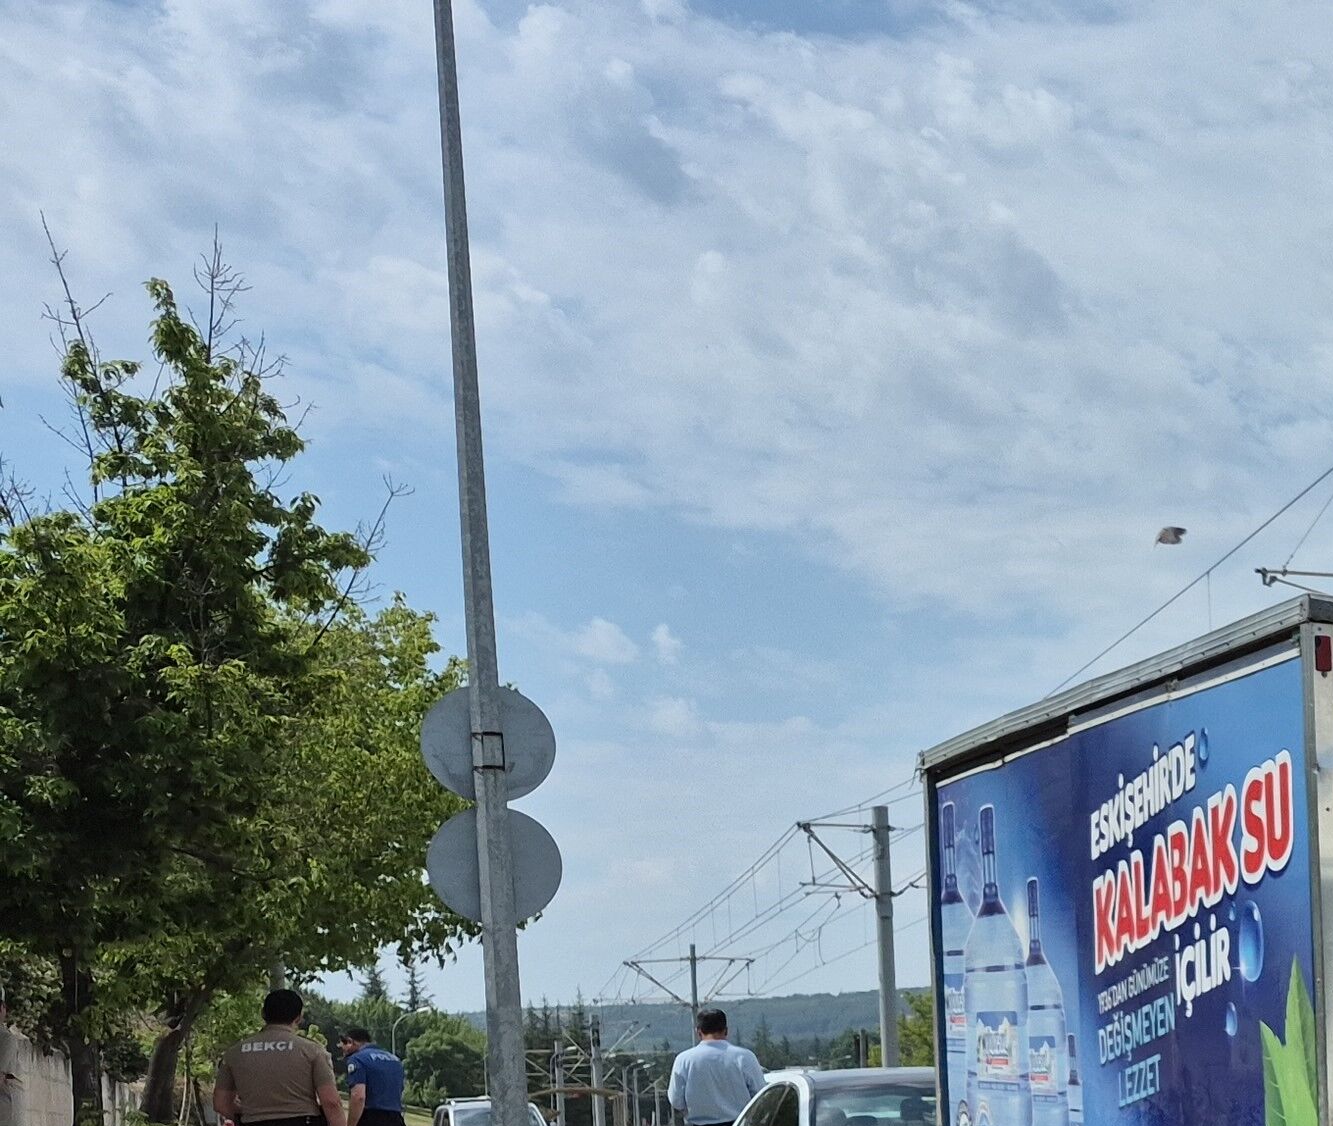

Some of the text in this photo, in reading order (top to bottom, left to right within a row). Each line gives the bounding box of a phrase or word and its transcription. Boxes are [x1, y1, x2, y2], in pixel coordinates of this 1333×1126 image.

[1092, 749, 1294, 976] KALABAK SU
[1127, 956, 1170, 998] GÜNÜMÜZE
[1173, 913, 1232, 1018] İÇİLİR
[1098, 992, 1176, 1065] DEĞİŞMEYEN
[1119, 1053, 1162, 1108] LEZZET
